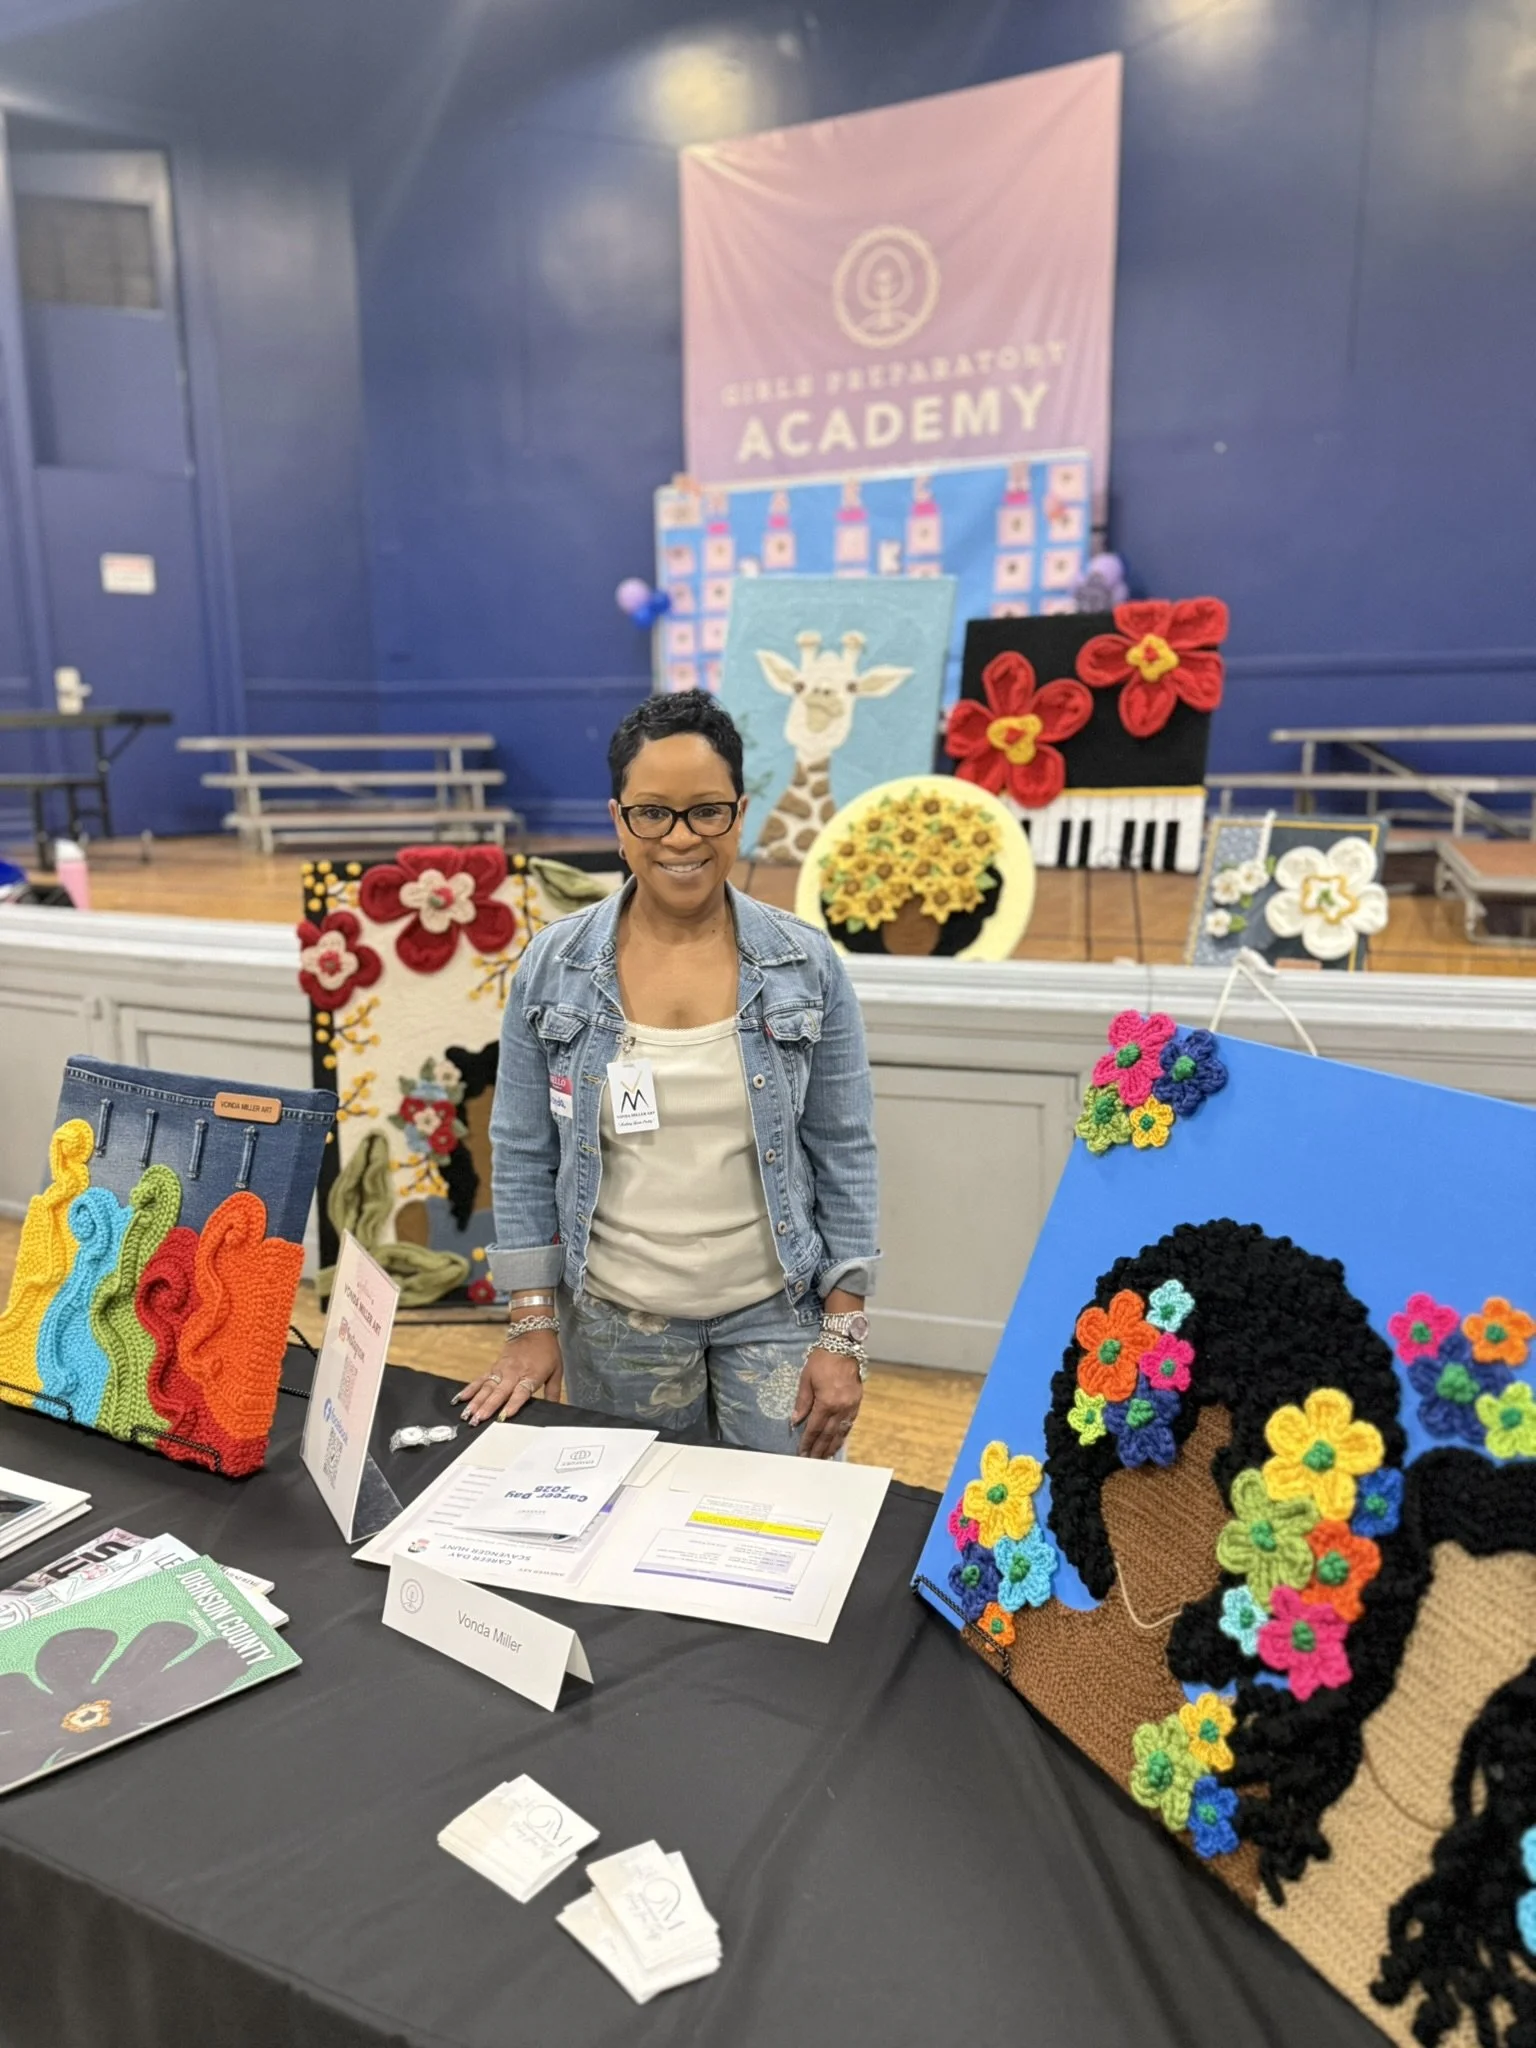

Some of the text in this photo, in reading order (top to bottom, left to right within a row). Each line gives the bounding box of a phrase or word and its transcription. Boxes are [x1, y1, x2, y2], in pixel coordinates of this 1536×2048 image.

[721, 340, 1067, 407] GIRLS PREPARATORY
[737, 381, 1050, 463] ACADEMY
[221, 1101, 240, 1109] VONDA
[241, 1103, 260, 1112] MILLER
[345, 1282, 359, 1307] VONDA
[359, 1301, 373, 1325] MILLER
[372, 1319, 381, 1336] ART
[504, 1490, 588, 1502] Career Day
[440, 1544, 531, 1561] SCAVENGER HUNT
[447, 1552, 512, 1565] CAREER DAY
[175, 1568, 236, 1621] JOHNSON
[216, 1615, 276, 1665] COUNTY
[457, 1610, 522, 1654] Vonda Miller
